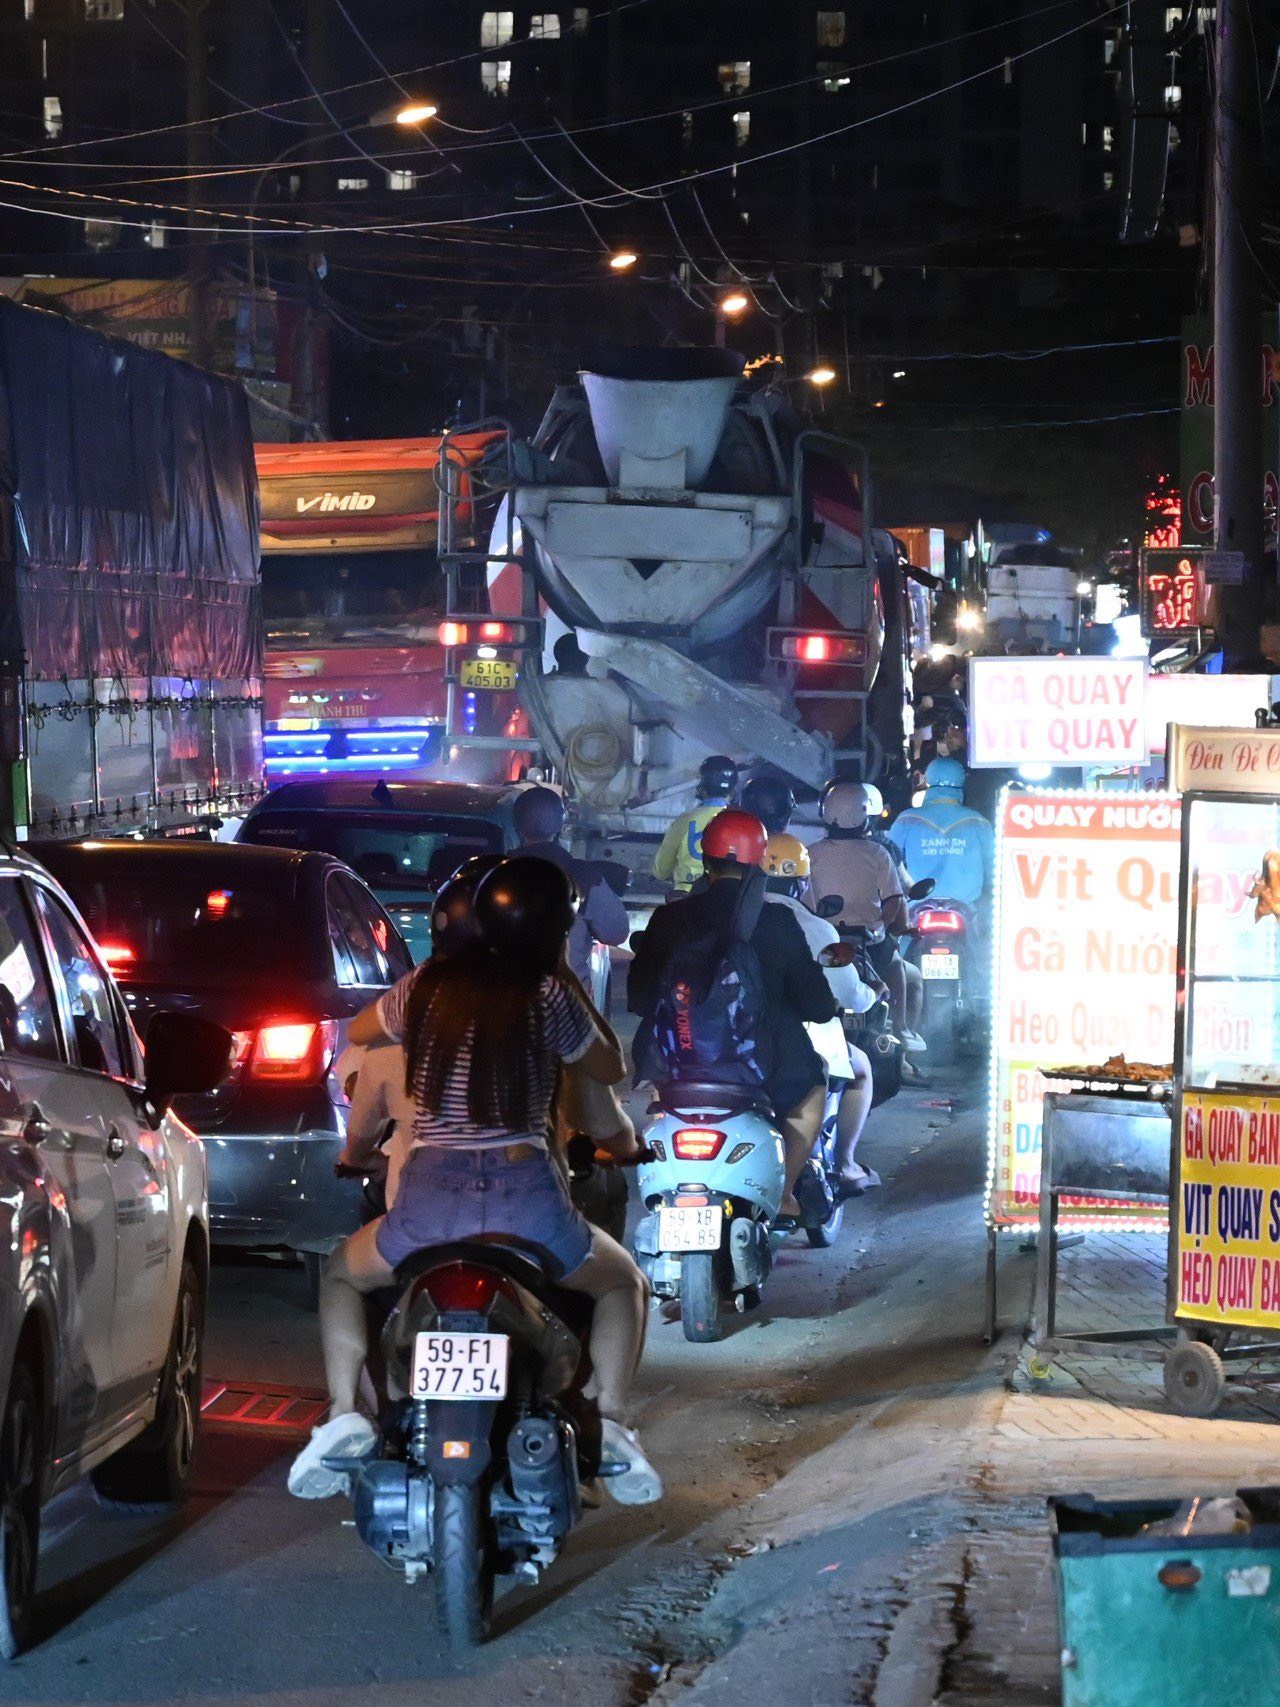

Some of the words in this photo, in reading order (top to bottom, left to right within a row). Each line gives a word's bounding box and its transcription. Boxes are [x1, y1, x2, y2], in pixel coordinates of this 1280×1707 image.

[466, 675, 510, 688] 405.03
[477, 662, 501, 674] 61C
[986, 666, 1029, 705] GÀ
[1042, 674, 1133, 711] QUAY
[982, 719, 1034, 757] VỊT
[1048, 718, 1138, 755] QUAY
[1010, 804, 1096, 829] QUAY
[1016, 854, 1092, 911] Vịt
[1013, 926, 1066, 974] Gà
[1009, 1000, 1059, 1045] Heo
[1071, 1001, 1132, 1055] Quay
[1184, 1097, 1204, 1160] GÀ
[1208, 1108, 1244, 1166] QUAY
[1184, 1183, 1212, 1247] VỊT
[1218, 1186, 1263, 1243] QUAY
[1182, 1252, 1212, 1306] HEO
[1217, 1255, 1257, 1312] QUAY
[427, 1338, 491, 1364] 59-F1
[418, 1367, 501, 1394] 377.54
